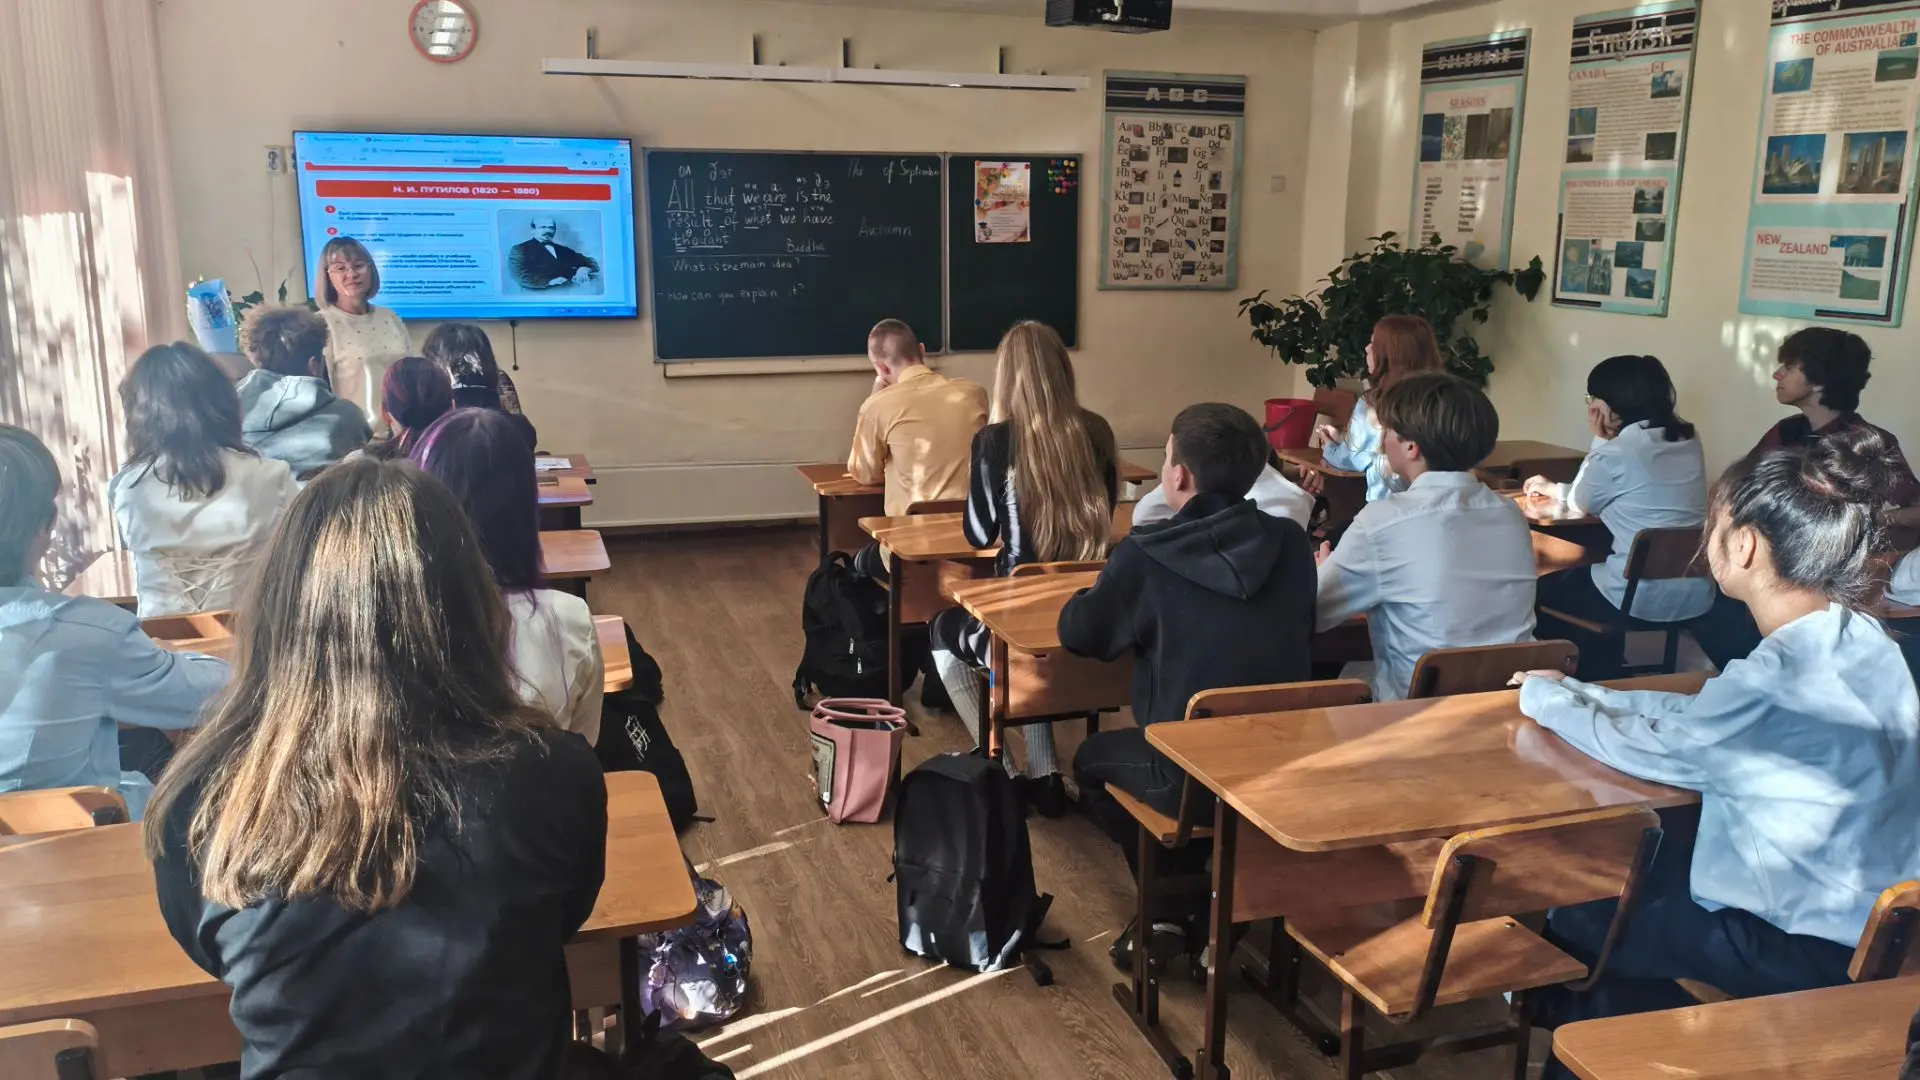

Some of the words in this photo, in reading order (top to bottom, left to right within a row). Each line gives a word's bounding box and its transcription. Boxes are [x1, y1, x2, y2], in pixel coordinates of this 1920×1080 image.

[1790, 34, 1813, 48] THE
[1813, 20, 1916, 43] COMMONWEALTH
[1816, 44, 1830, 56] OF
[1834, 36, 1900, 54] AUSTRALIA
[1149, 121, 1162, 132] Bb
[1203, 126, 1217, 136] Dd
[1151, 136, 1165, 146] Bb
[1208, 140, 1221, 149] Dd
[1193, 147, 1208, 159] Gg
[419, 186, 470, 194] ПУТИЛОВ
[471, 186, 498, 196] (1820
[666, 179, 696, 211] All
[704, 186, 737, 206] that
[742, 192, 762, 205] we
[762, 192, 788, 204] are
[796, 189, 809, 204] is
[811, 188, 834, 203] the
[1114, 191, 1128, 201] Kk
[1172, 193, 1190, 203] Mm
[1199, 193, 1212, 203] Nn
[803, 207, 834, 224] have
[1113, 215, 1128, 224] Oo
[1143, 215, 1154, 226] Pp
[1115, 227, 1127, 235] Oo
[1756, 233, 1783, 246] NEW
[1779, 242, 1829, 256] ZEALAND
[672, 258, 706, 273] What
[740, 261, 766, 270] main
[1154, 263, 1165, 279] 6
[690, 291, 712, 300] can
